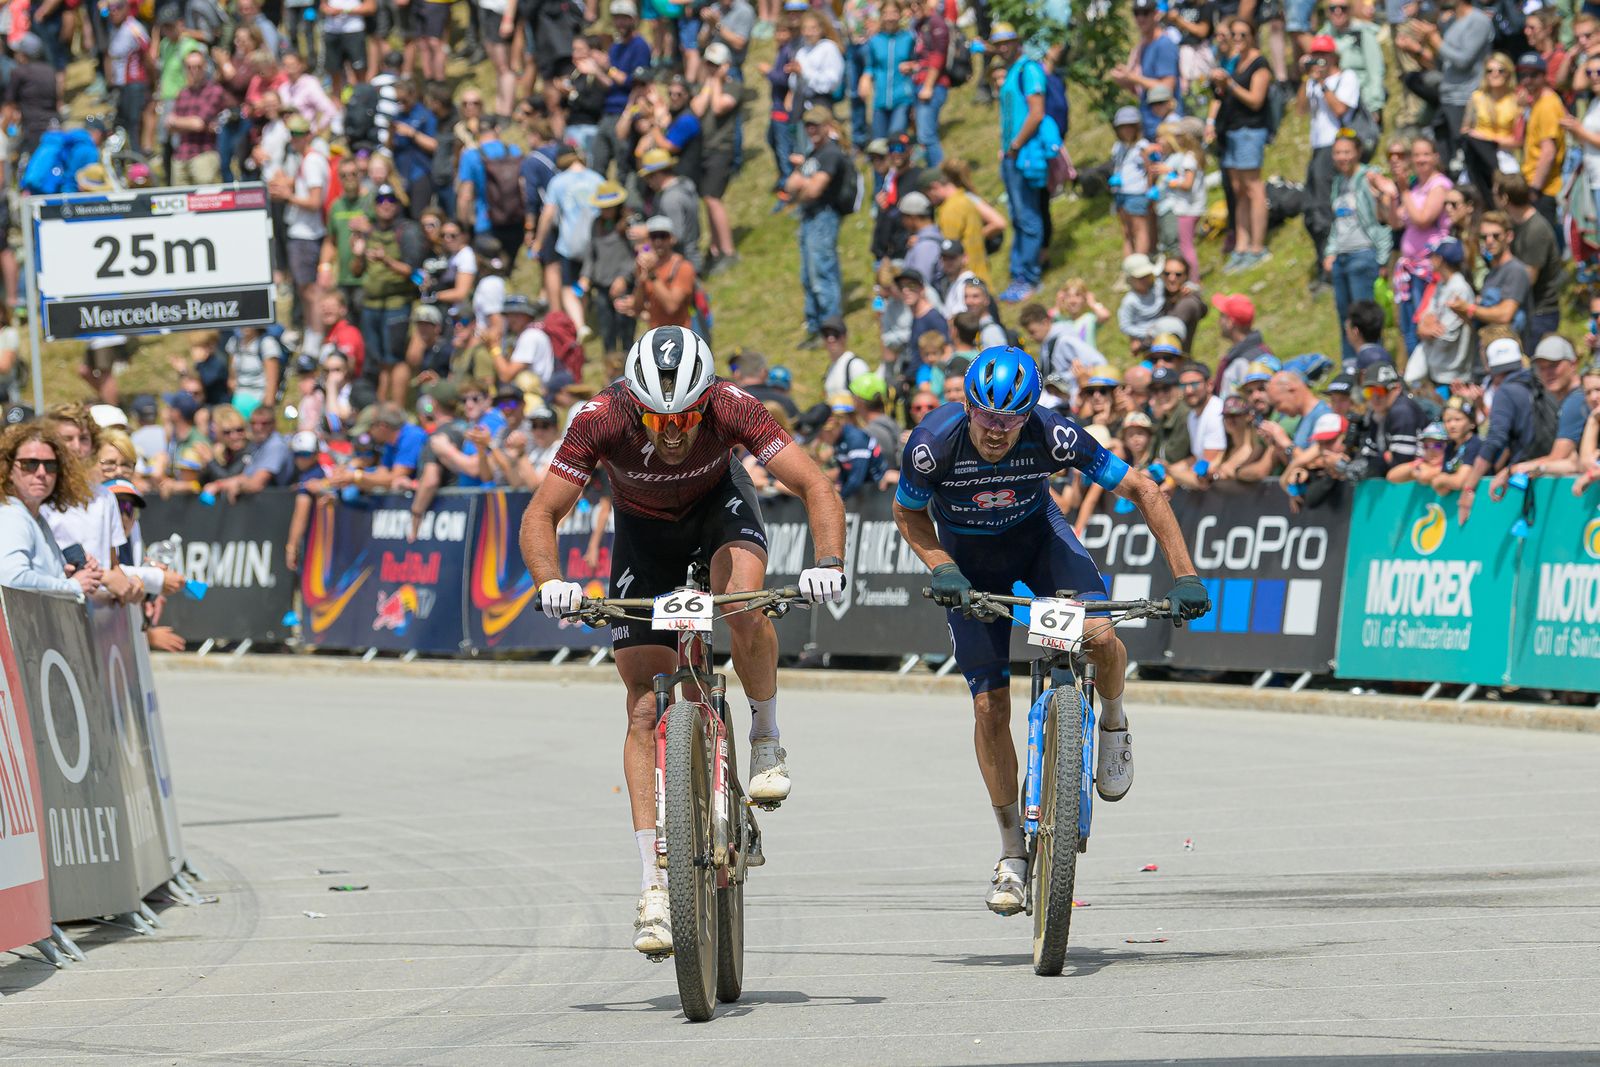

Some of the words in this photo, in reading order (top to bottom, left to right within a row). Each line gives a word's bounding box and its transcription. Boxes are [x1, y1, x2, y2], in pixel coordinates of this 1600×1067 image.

[93, 233, 217, 279] 25m
[79, 298, 239, 329] Mercedes-Benz
[434, 510, 468, 542] ON
[1194, 515, 1328, 571] GoPro
[1365, 558, 1480, 617] MOTOREX
[1536, 561, 1600, 624] MOTO
[663, 596, 704, 613] 66
[1040, 608, 1076, 632] 67
[1362, 619, 1381, 648] Oil
[1381, 620, 1398, 648] of
[1397, 619, 1472, 651] Switzerland
[1534, 625, 1554, 655] Oil
[1554, 626, 1570, 656] of
[48, 806, 120, 867] OAKLEY
